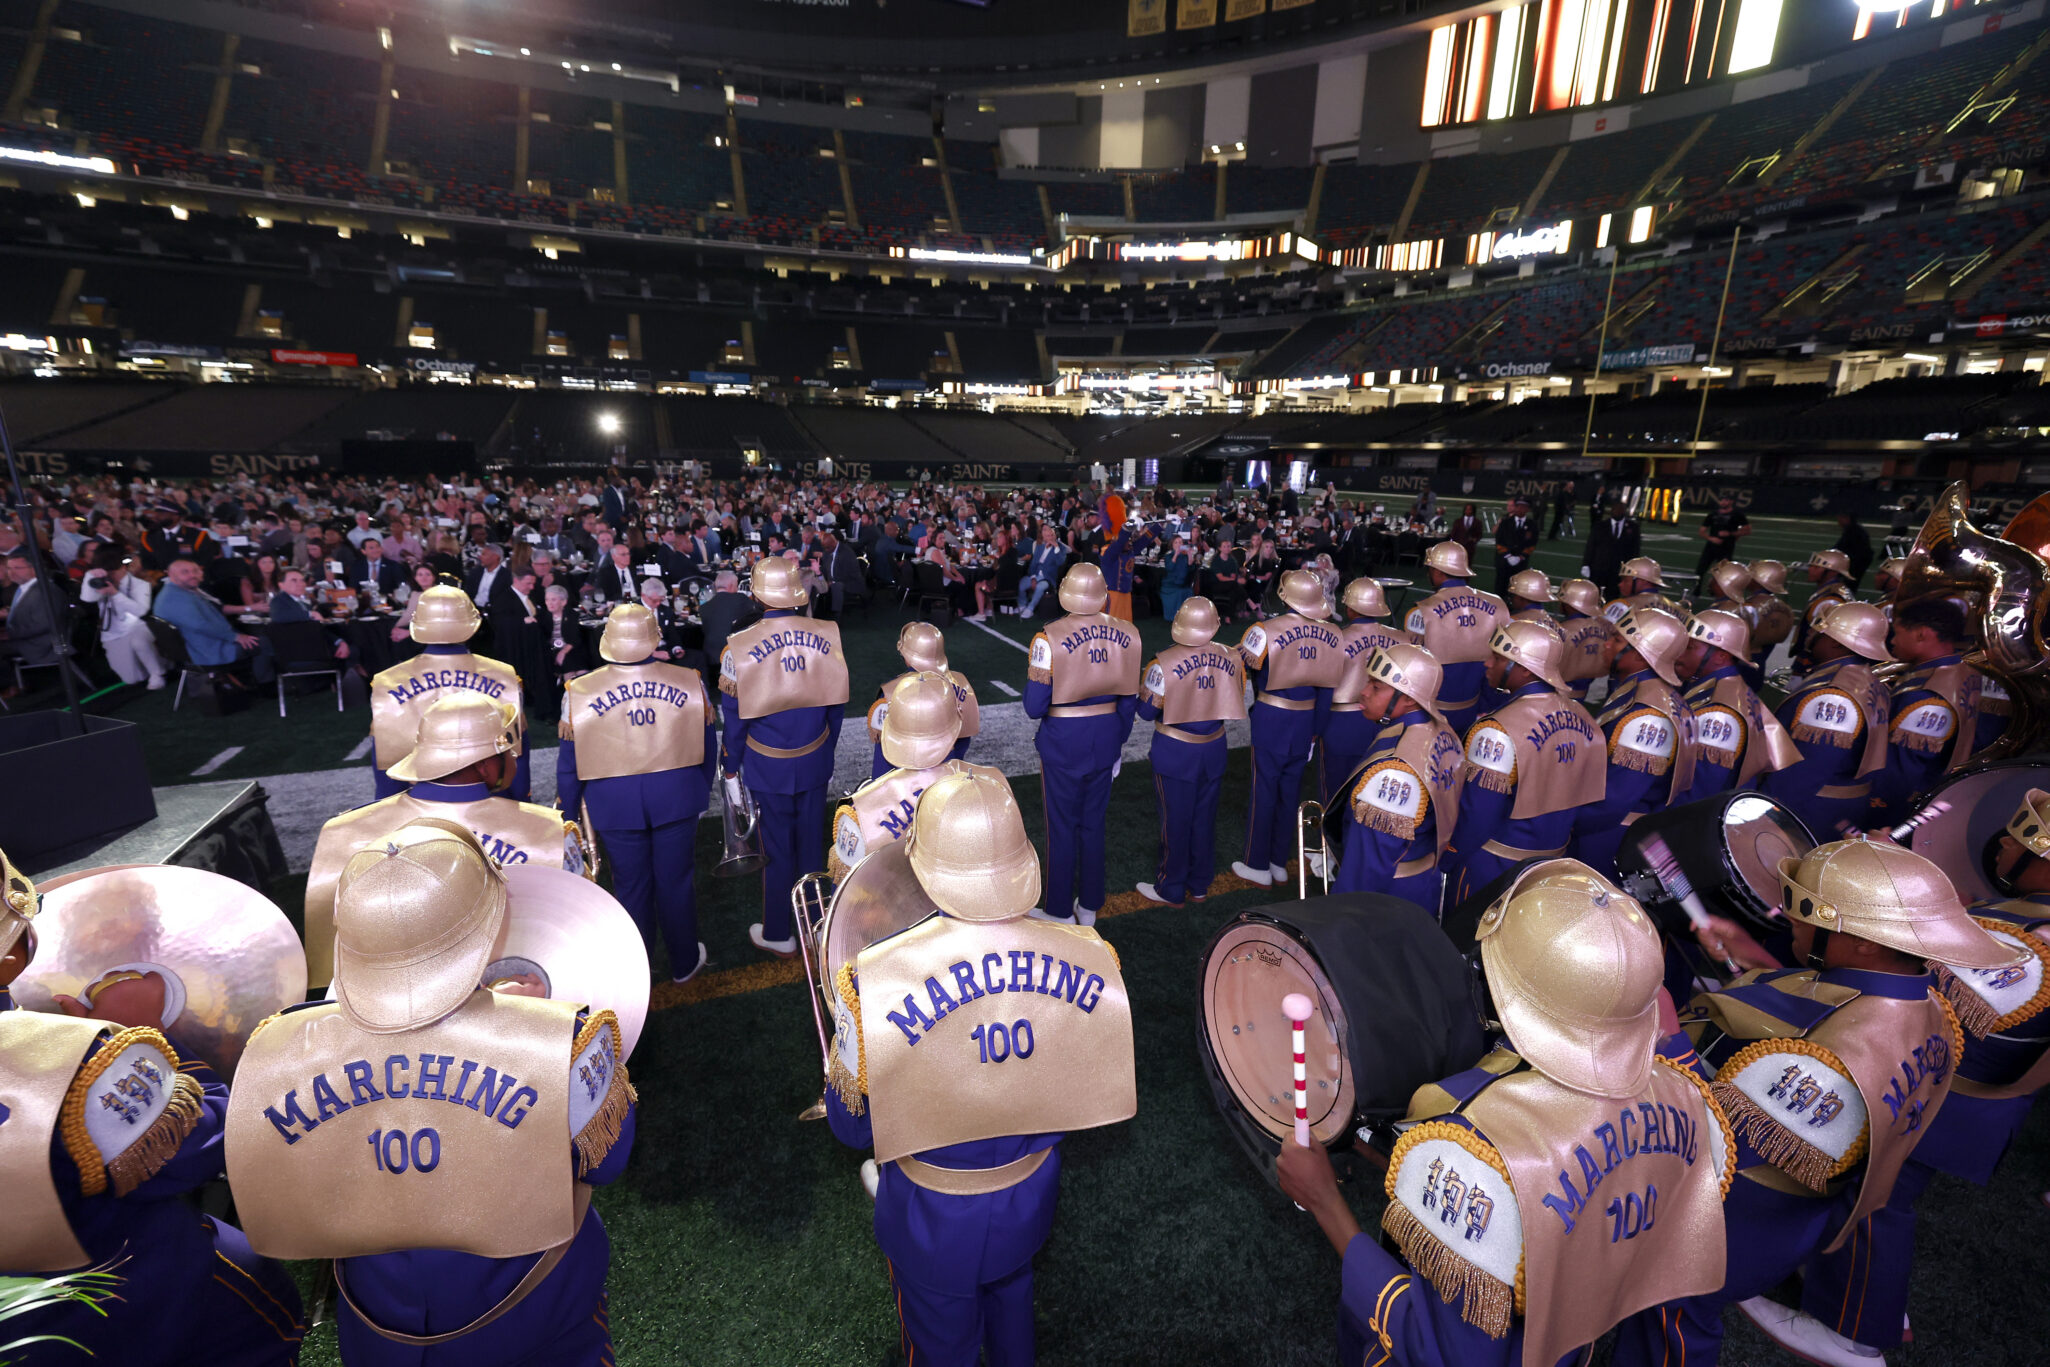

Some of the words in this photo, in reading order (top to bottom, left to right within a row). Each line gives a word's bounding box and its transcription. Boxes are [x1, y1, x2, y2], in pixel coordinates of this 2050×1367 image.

[1754, 198, 1806, 216] VENTURE
[1851, 323, 1915, 343] SAINTS
[1724, 337, 1777, 351] SAINTS
[414, 358, 476, 374] Ochsner
[1486, 361, 1551, 378] Ochsner
[803, 379, 830, 388] entergy
[209, 454, 318, 475] SAINT
[803, 462, 872, 479] SNTS
[952, 464, 1011, 480] SAINTS
[1379, 475, 1430, 491] SAINTS
[1504, 479, 1559, 496] SAINT
[1671, 486, 1753, 508] AINTS
[1433, 595, 1497, 619] MARCHING
[1457, 614, 1476, 627] 100
[748, 630, 831, 664] MARCHING
[1061, 624, 1132, 655] MARCHING
[1274, 625, 1339, 650] MARCHING
[1345, 635, 1400, 660] MARCHIN
[1088, 648, 1109, 664] 100
[1298, 646, 1317, 660] 100
[781, 655, 806, 673] 100
[1172, 652, 1236, 680] MARCHING
[388, 669, 507, 705] MARCHING
[1196, 675, 1216, 690] 100
[588, 681, 689, 718] MARCHING
[627, 708, 657, 727] 100
[1526, 710, 1595, 752] MARCHING
[1556, 741, 1577, 764] 100
[887, 950, 1105, 1047] MARCHING
[971, 1018, 1034, 1064] 100
[264, 1053, 539, 1146] MARCHING
[368, 1128, 441, 1175] 100
[1605, 1183, 1659, 1244] 100
